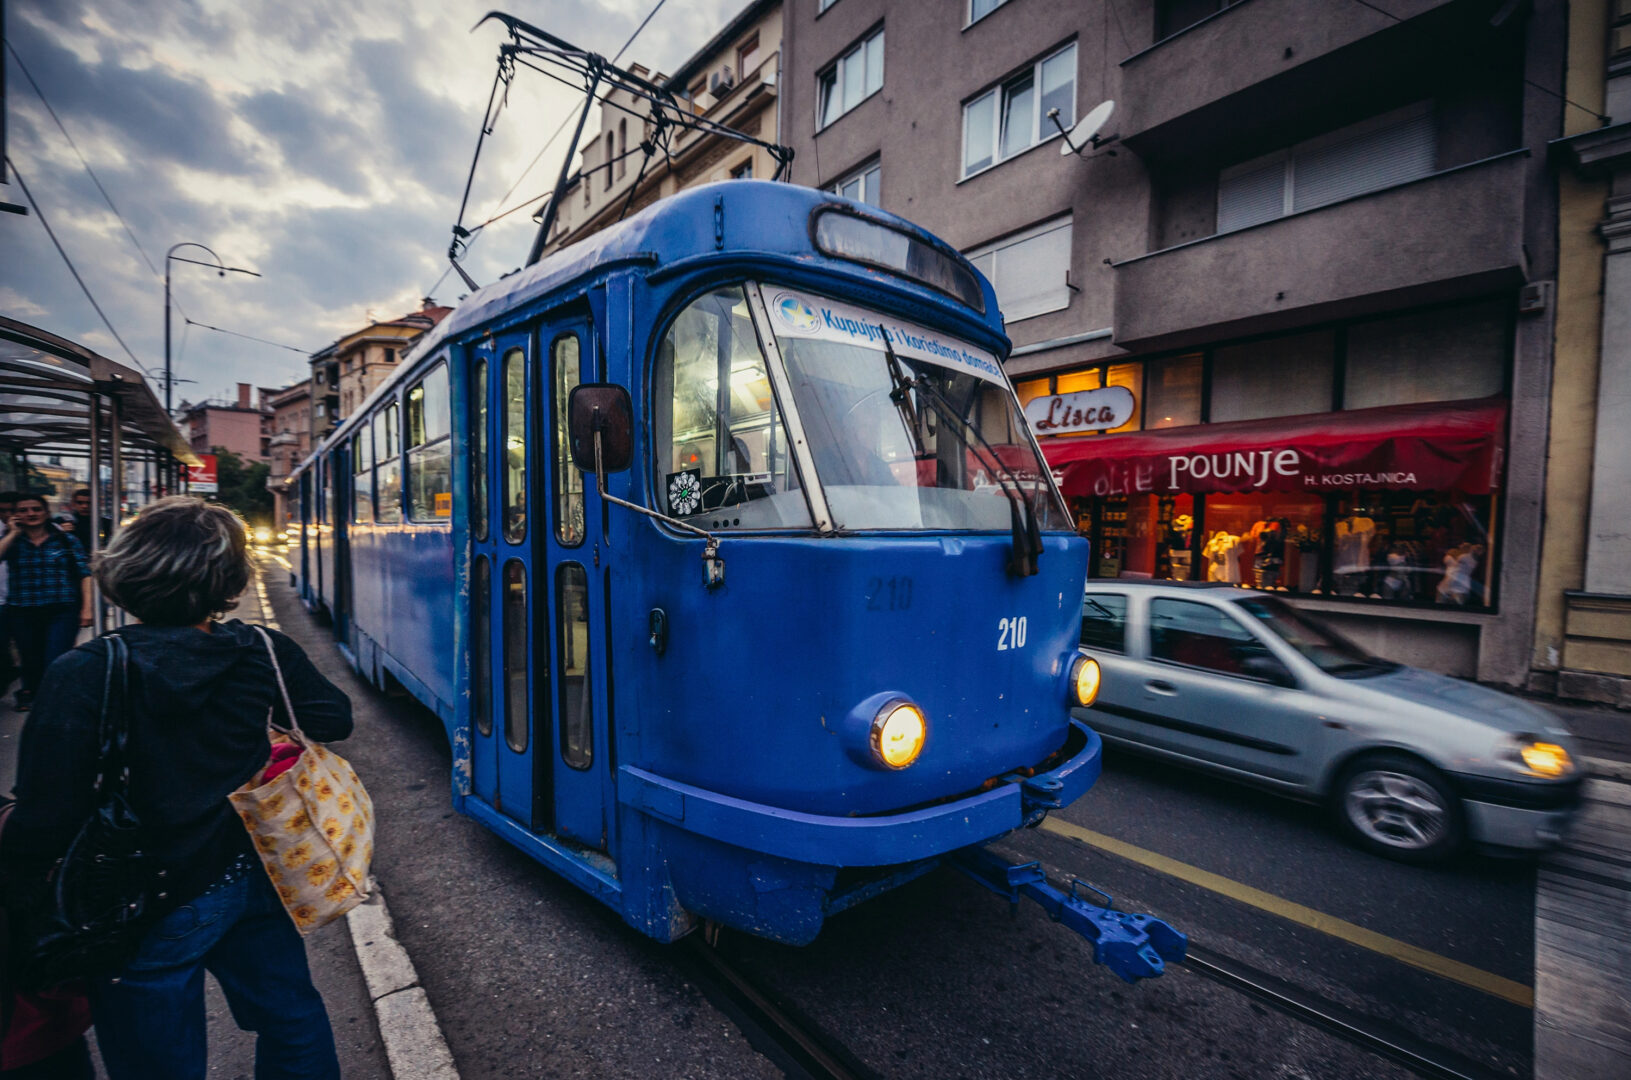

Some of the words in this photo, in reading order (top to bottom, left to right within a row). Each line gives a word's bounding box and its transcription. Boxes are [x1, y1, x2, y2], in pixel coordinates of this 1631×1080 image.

[900, 329, 962, 363] koristimo
[1036, 397, 1115, 430] Lisca
[1321, 472, 1418, 486] KOSTAJNICA
[997, 616, 1027, 651] 210
